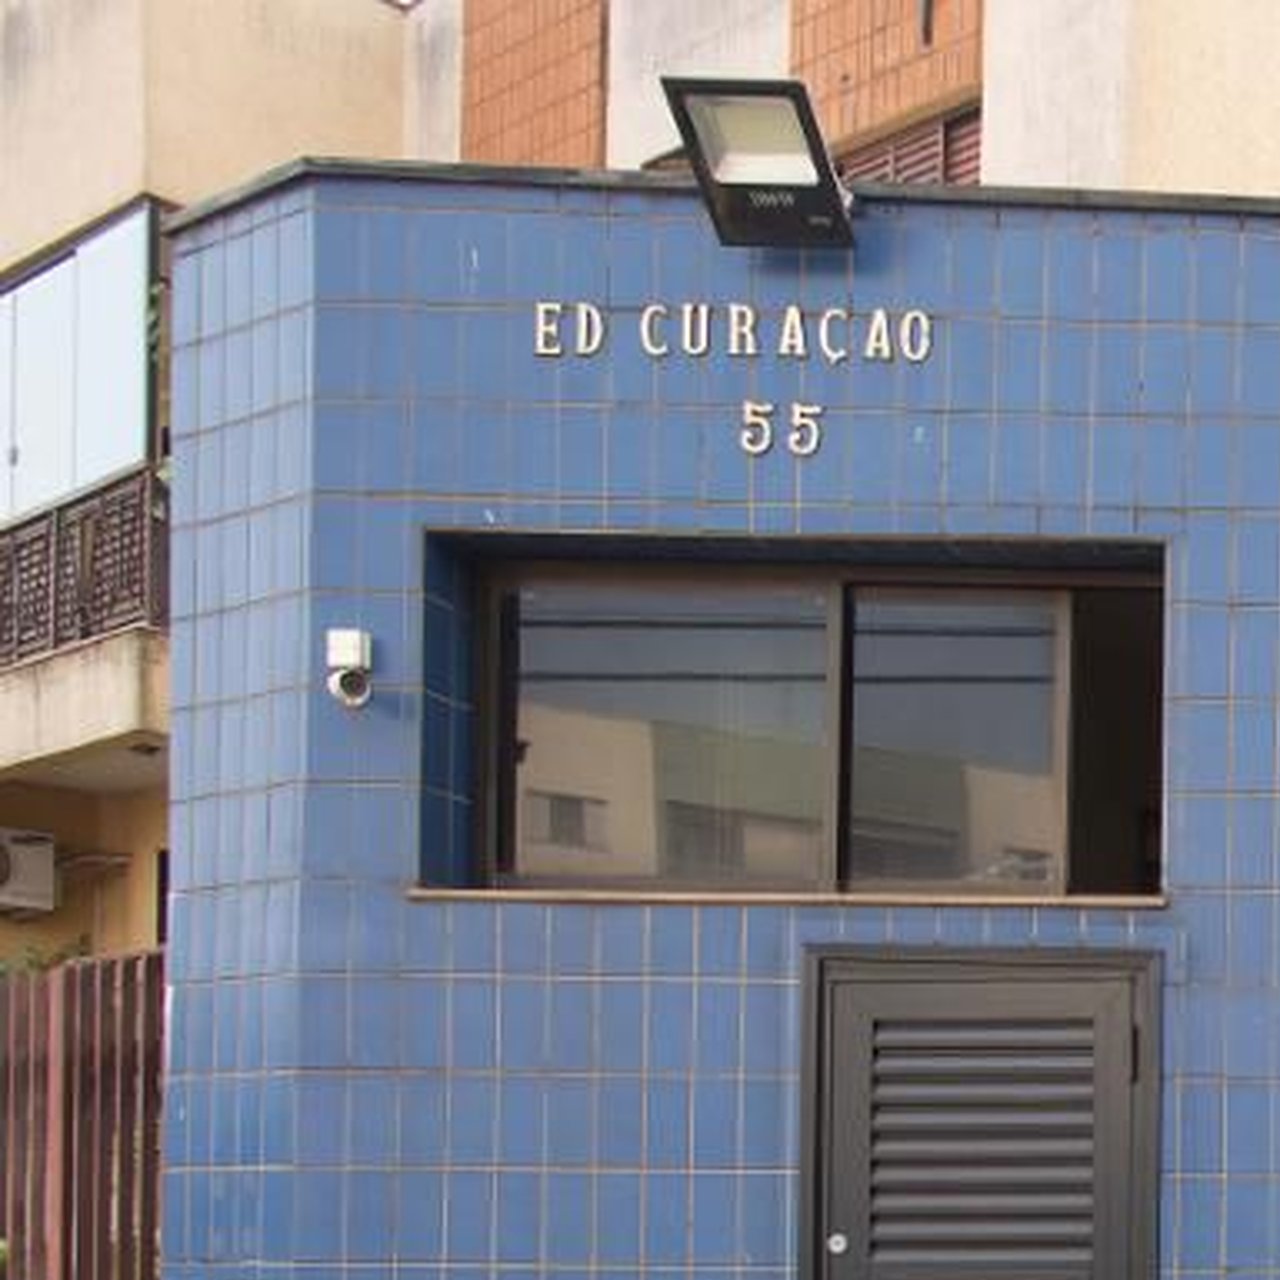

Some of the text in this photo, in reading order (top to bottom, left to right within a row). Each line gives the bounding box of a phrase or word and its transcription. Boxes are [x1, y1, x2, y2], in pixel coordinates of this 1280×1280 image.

[535, 303, 931, 363] ED CURAÇAO
[740, 401, 822, 455] 55
